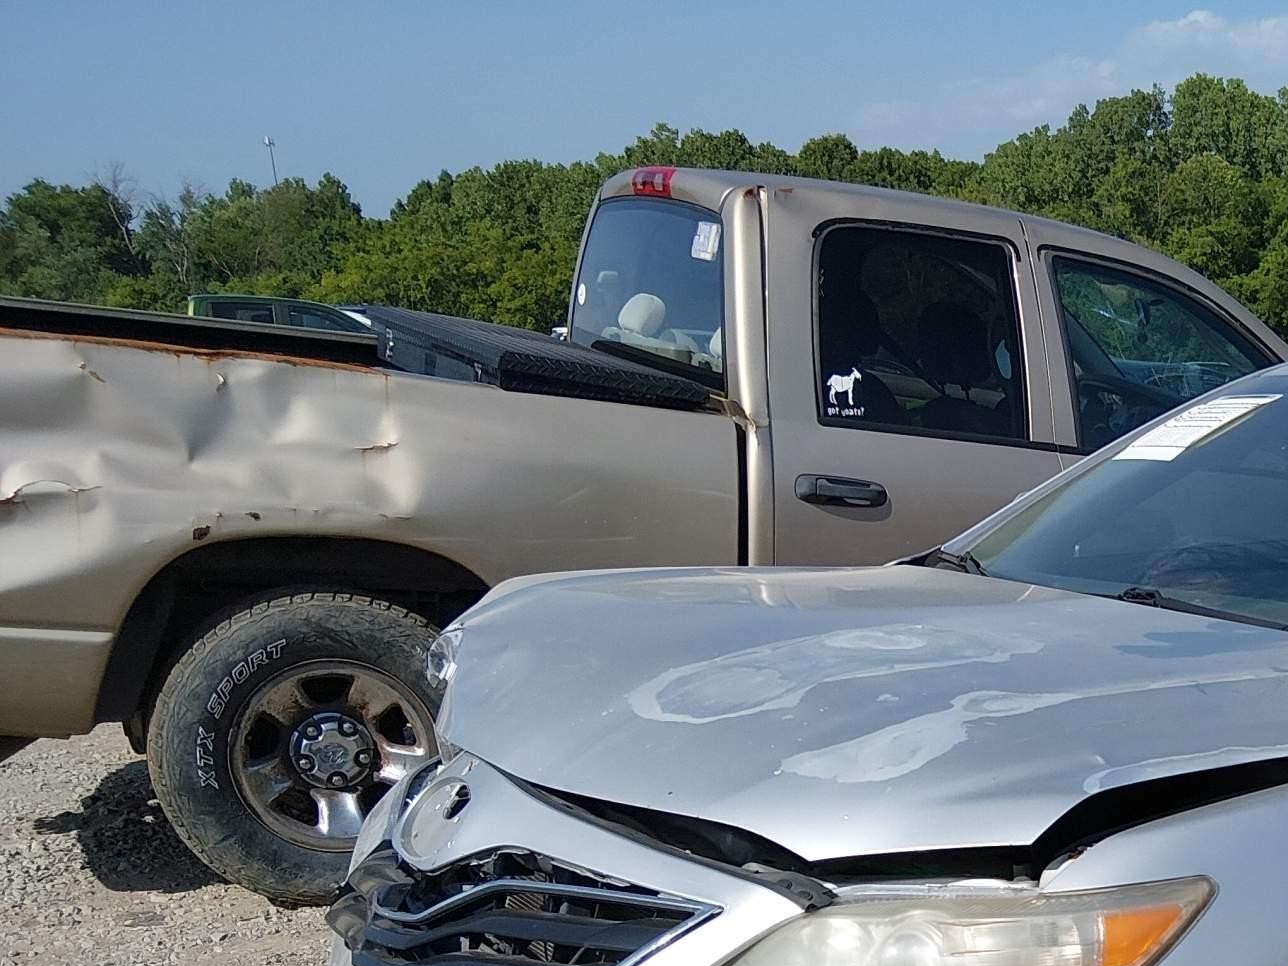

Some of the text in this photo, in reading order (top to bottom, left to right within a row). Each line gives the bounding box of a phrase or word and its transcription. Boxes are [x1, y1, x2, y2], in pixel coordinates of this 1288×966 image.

[827, 406, 839, 416] got
[194, 638, 288, 790] XTX SPORT
